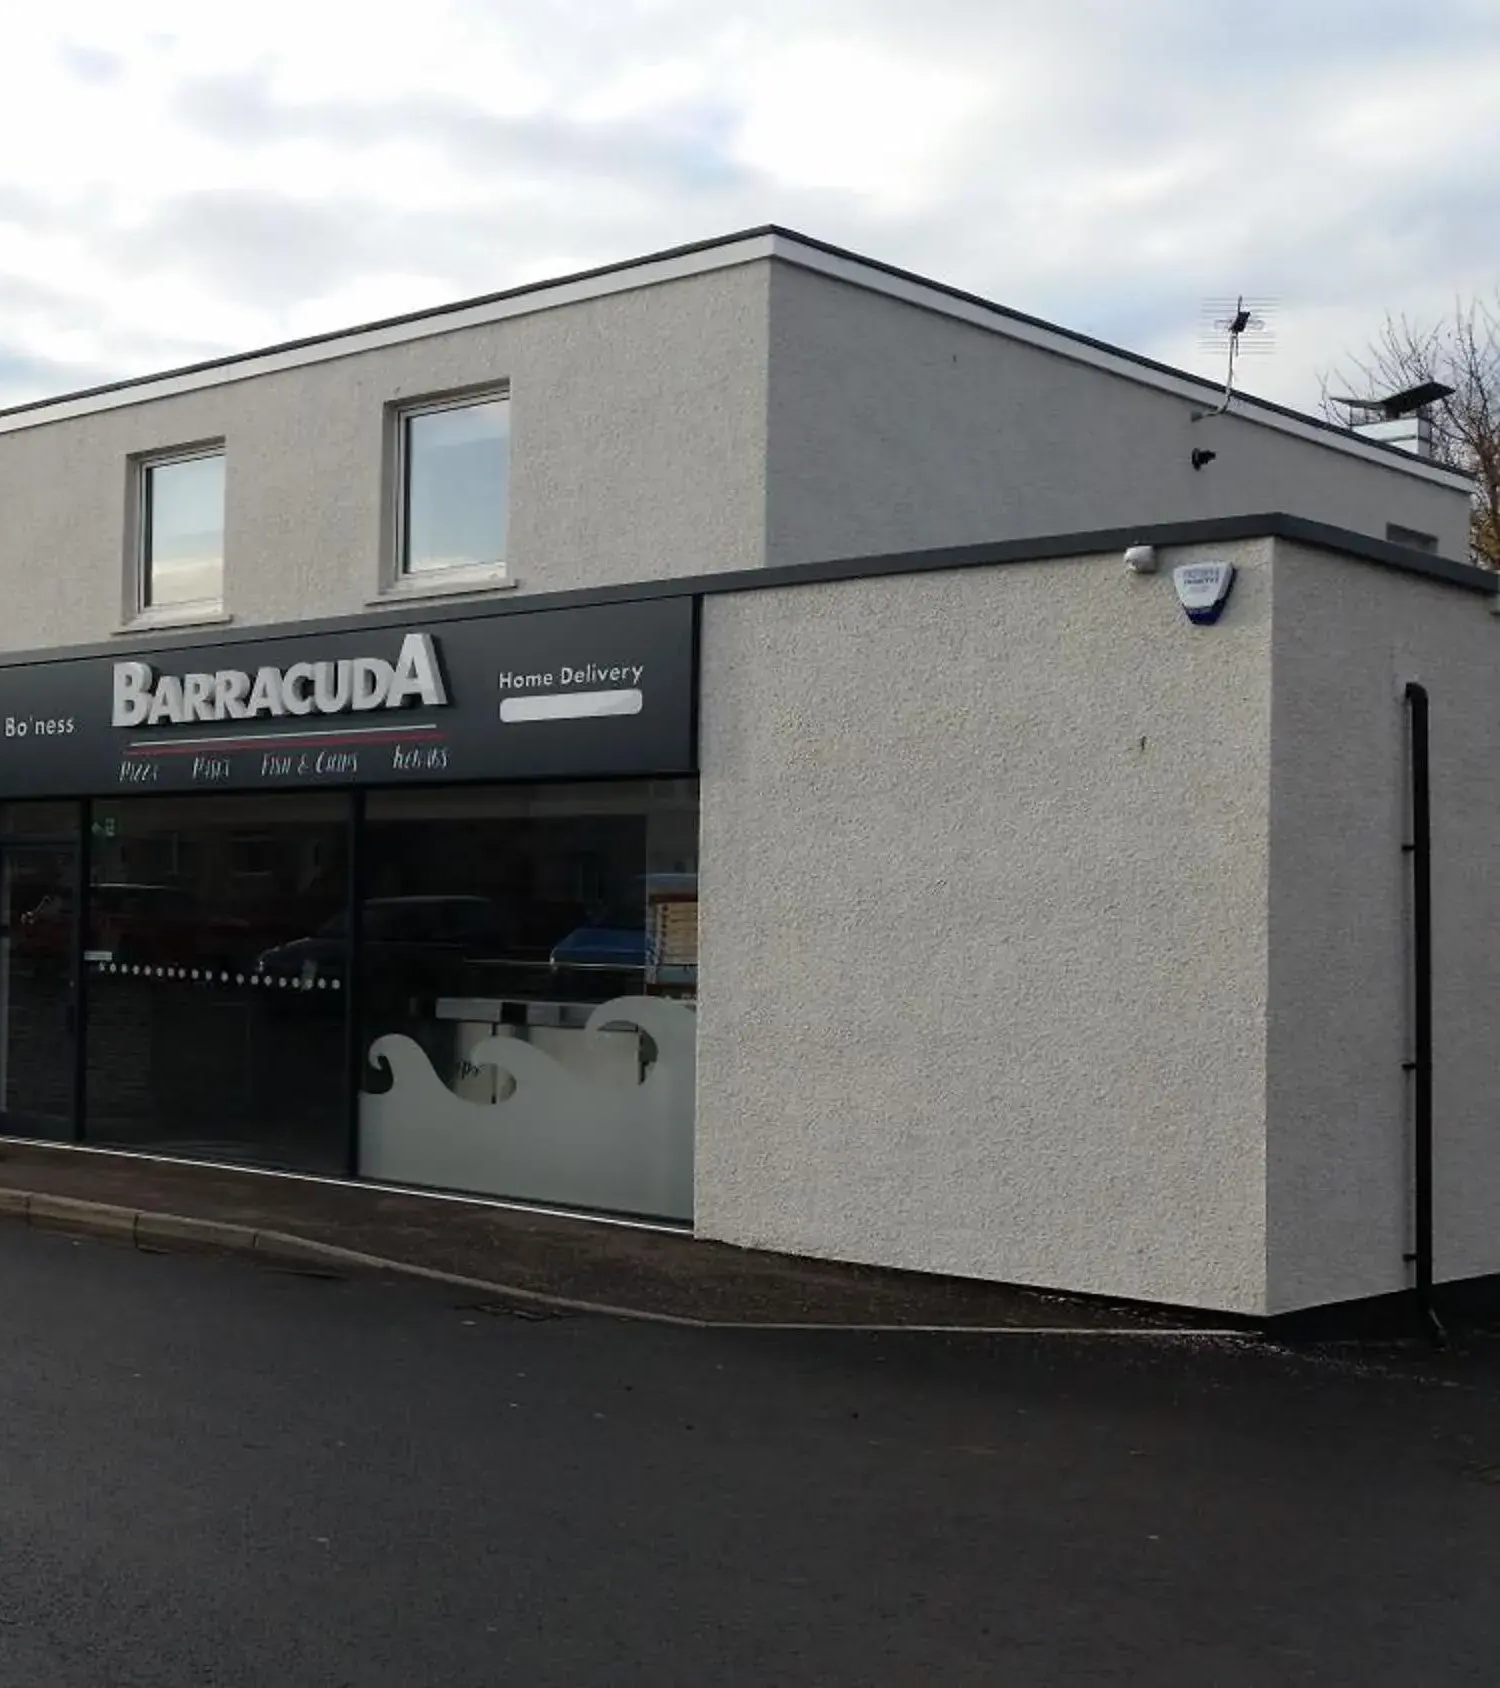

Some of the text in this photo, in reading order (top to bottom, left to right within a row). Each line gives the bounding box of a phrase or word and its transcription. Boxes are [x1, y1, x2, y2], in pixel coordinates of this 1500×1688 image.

[112, 632, 448, 727] BARRACUDA
[499, 663, 644, 689] Home Delivery
[5, 715, 75, 737] Bo'ness
